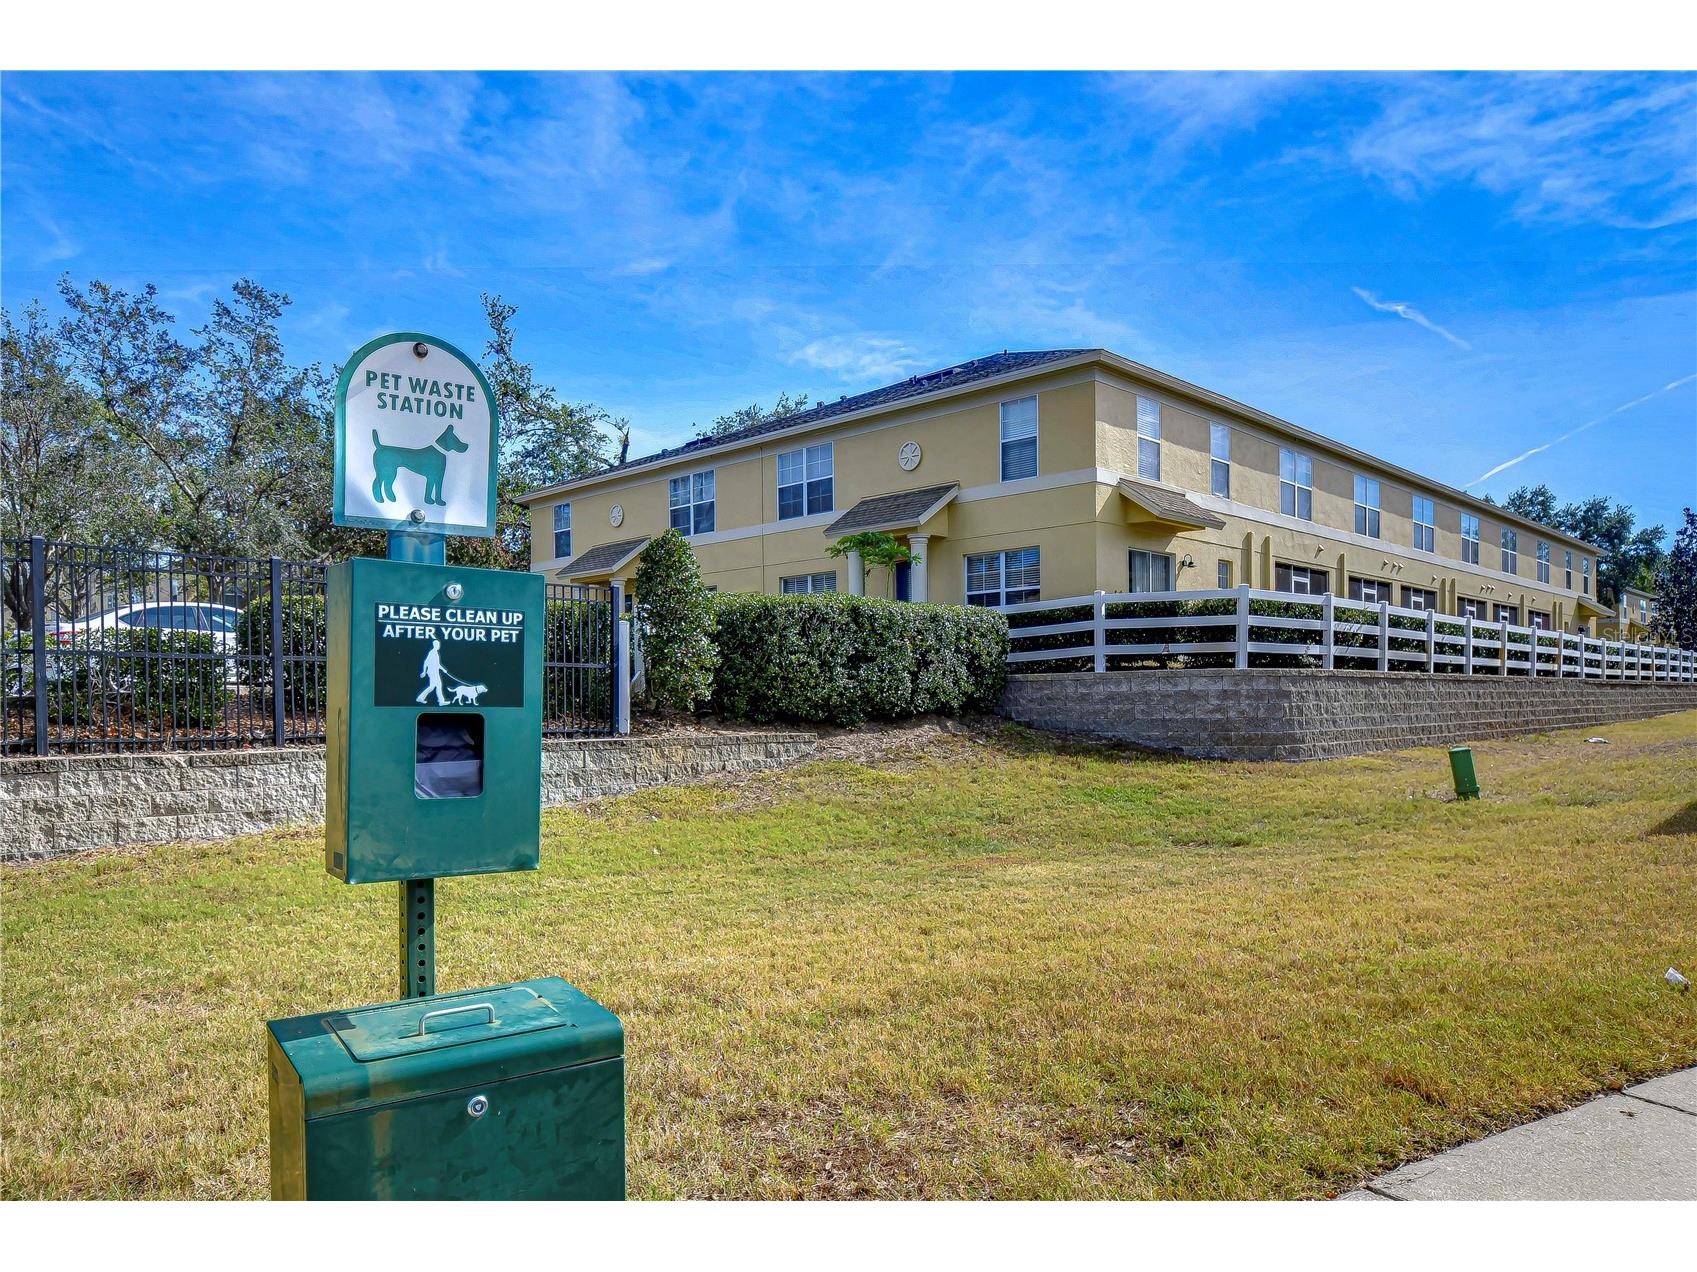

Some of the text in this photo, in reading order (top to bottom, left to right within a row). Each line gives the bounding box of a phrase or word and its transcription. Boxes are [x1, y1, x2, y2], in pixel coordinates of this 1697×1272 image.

[365, 370, 475, 402] PET WASTE
[377, 392, 463, 419] STATION
[378, 605, 523, 625] PLEASE CLEAN UP
[383, 625, 520, 643] AFTER YOUR PET
